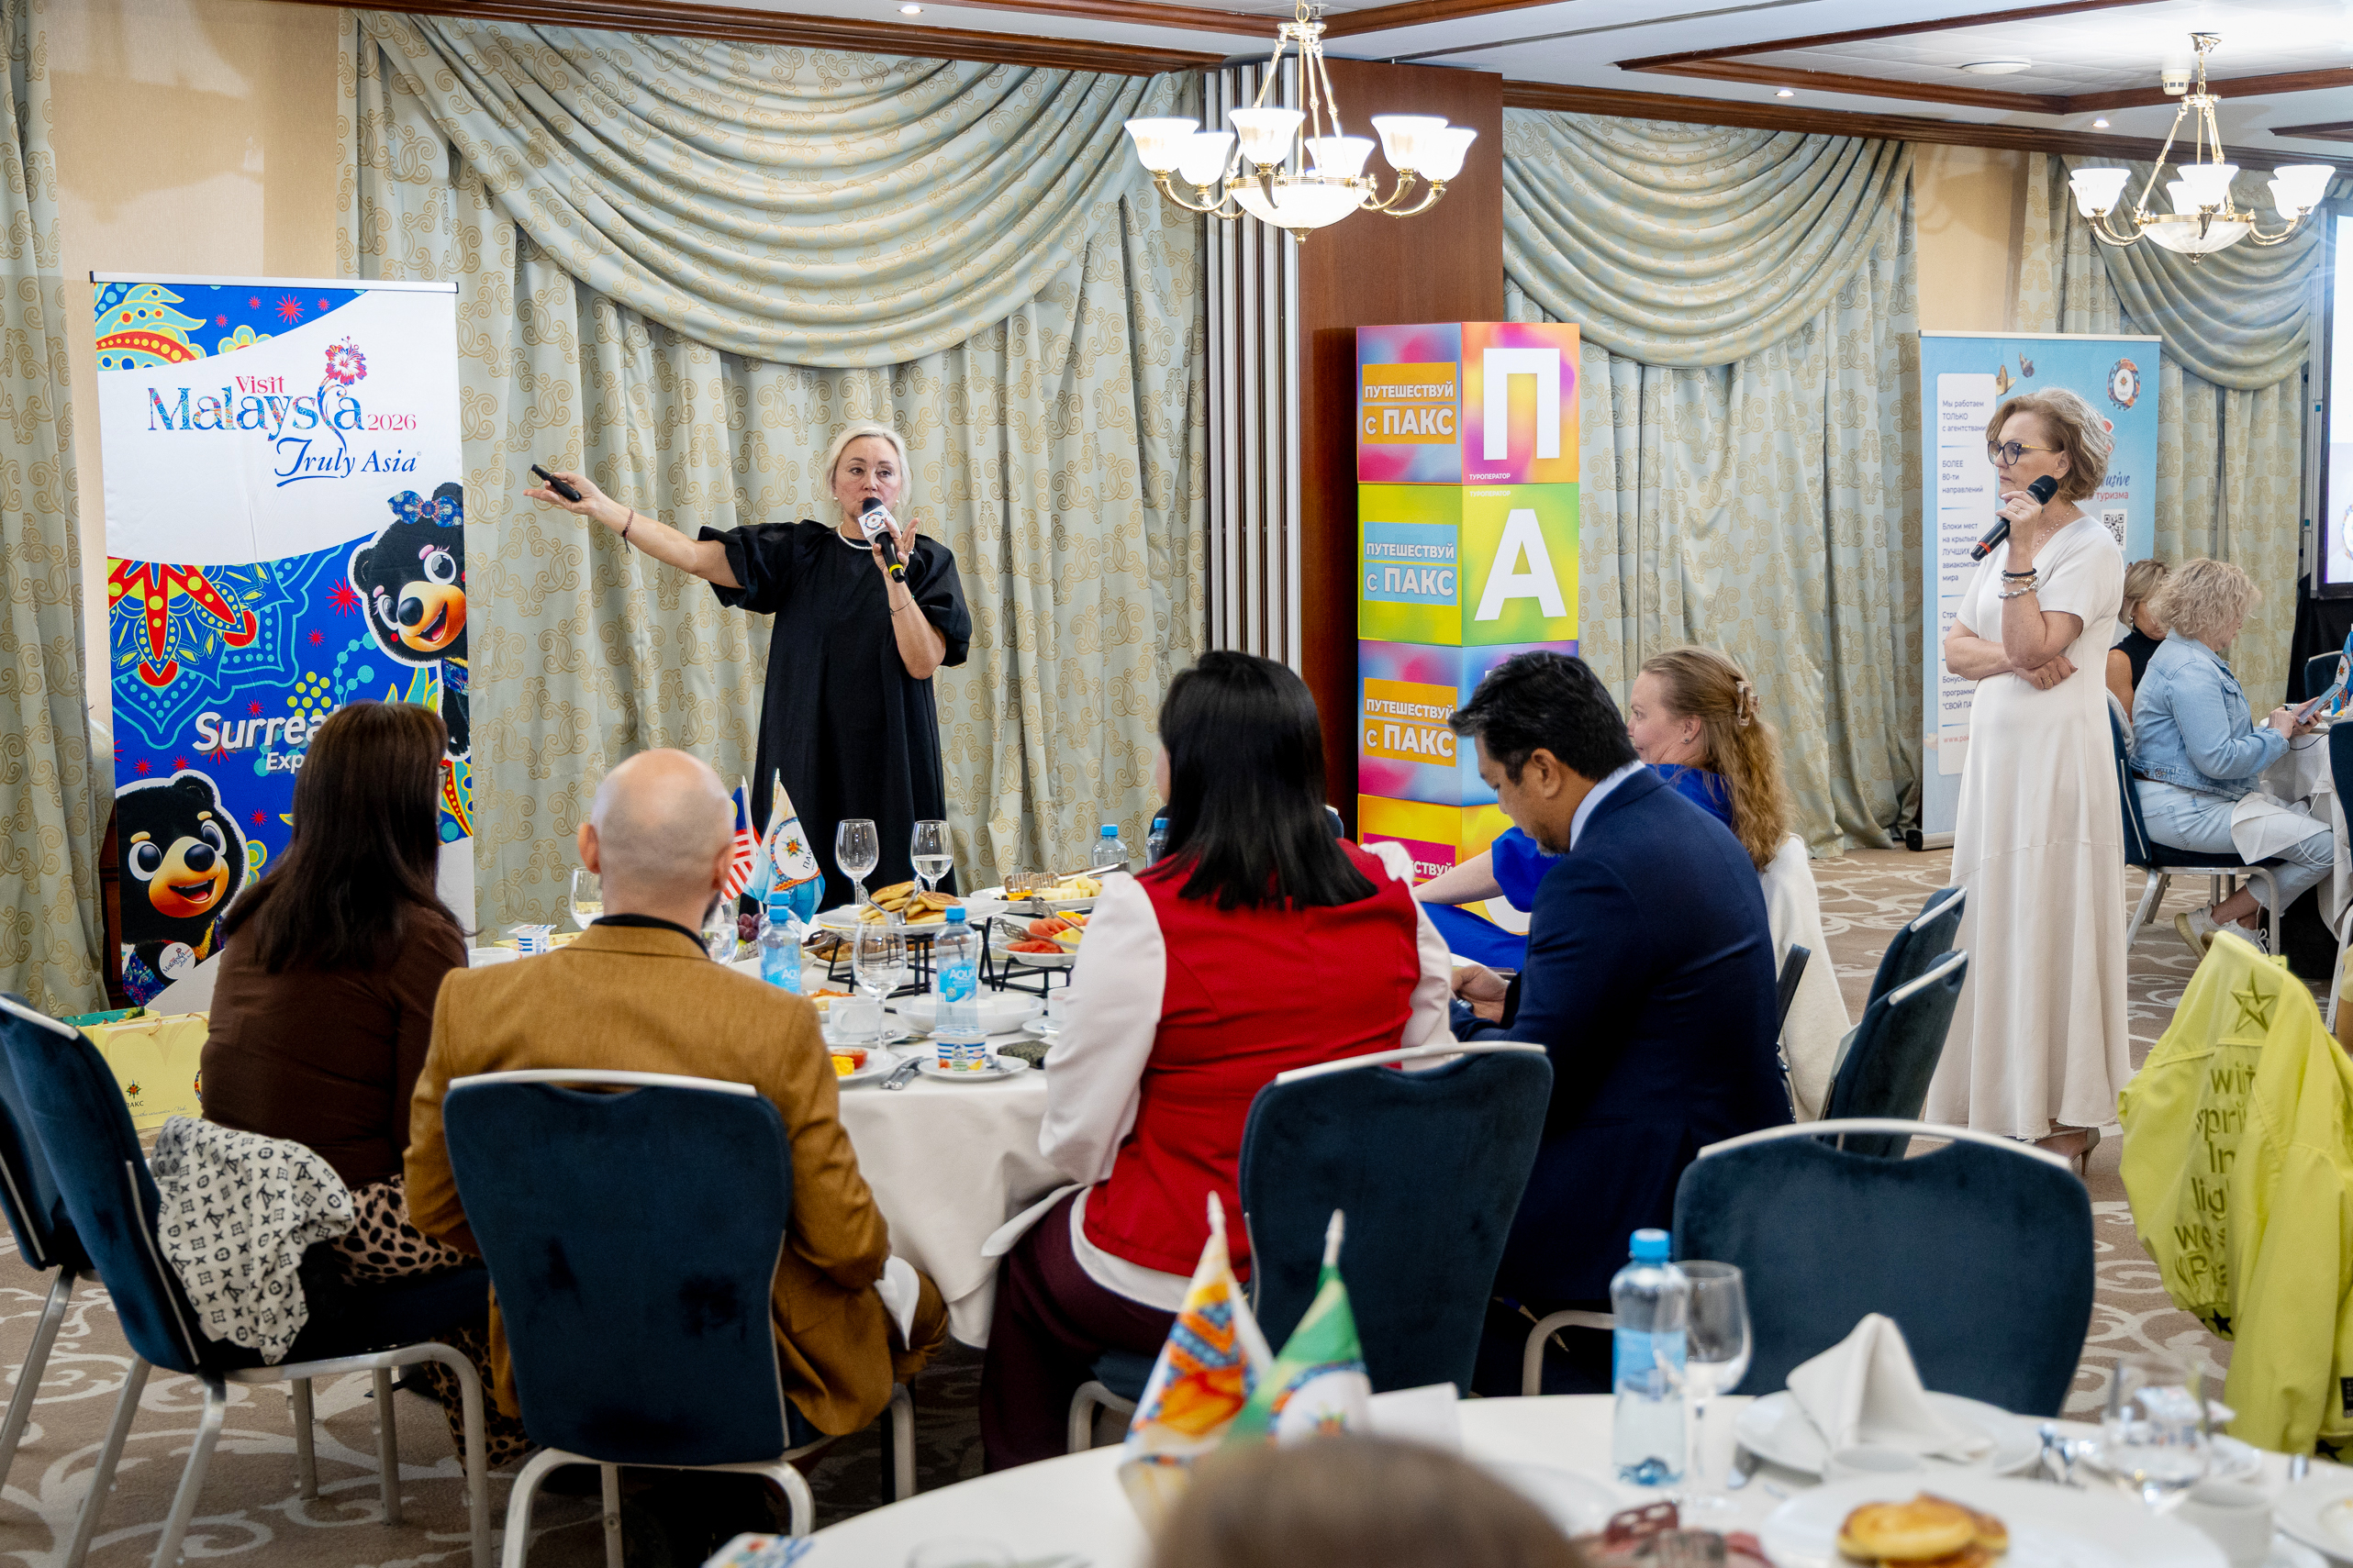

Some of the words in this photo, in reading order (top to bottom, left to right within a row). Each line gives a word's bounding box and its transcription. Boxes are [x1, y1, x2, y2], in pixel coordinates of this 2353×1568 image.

[235, 375, 285, 395] Visit
[1365, 381, 1455, 399] ПУТЕШЕСТВУЙ
[1483, 348, 1560, 461] П
[1954, 399, 1984, 408] работаем
[367, 413, 418, 431] 2026
[1382, 407, 1455, 436] ПАКС
[1942, 412, 1968, 420] ТОЛЬКО
[274, 438, 356, 481] Truly
[361, 449, 418, 473] Asia
[1942, 460, 1964, 468] БОЛЕЕ
[1468, 473, 1511, 481] ТУРОПЕРАТОР
[1942, 484, 1984, 495] направлений
[2096, 491, 2129, 502] туризма
[1942, 522, 1962, 530] Блоки
[1951, 535, 1978, 543] крыльях
[1366, 542, 1455, 559] ПУТЕШЕСТВУЙ
[1942, 548, 1970, 556] ЛУЧШИХ
[1474, 508, 1567, 621] А
[1384, 566, 1455, 597] ПАКС
[1942, 573, 1959, 582] мира
[1963, 700, 1972, 708] ПА
[192, 705, 341, 751] Surrea
[1383, 724, 1455, 758] ПАКС
[1944, 734, 1969, 743] www.pak
[802, 848, 813, 870] ПАК
[2196, 1102, 2247, 1141] spri
